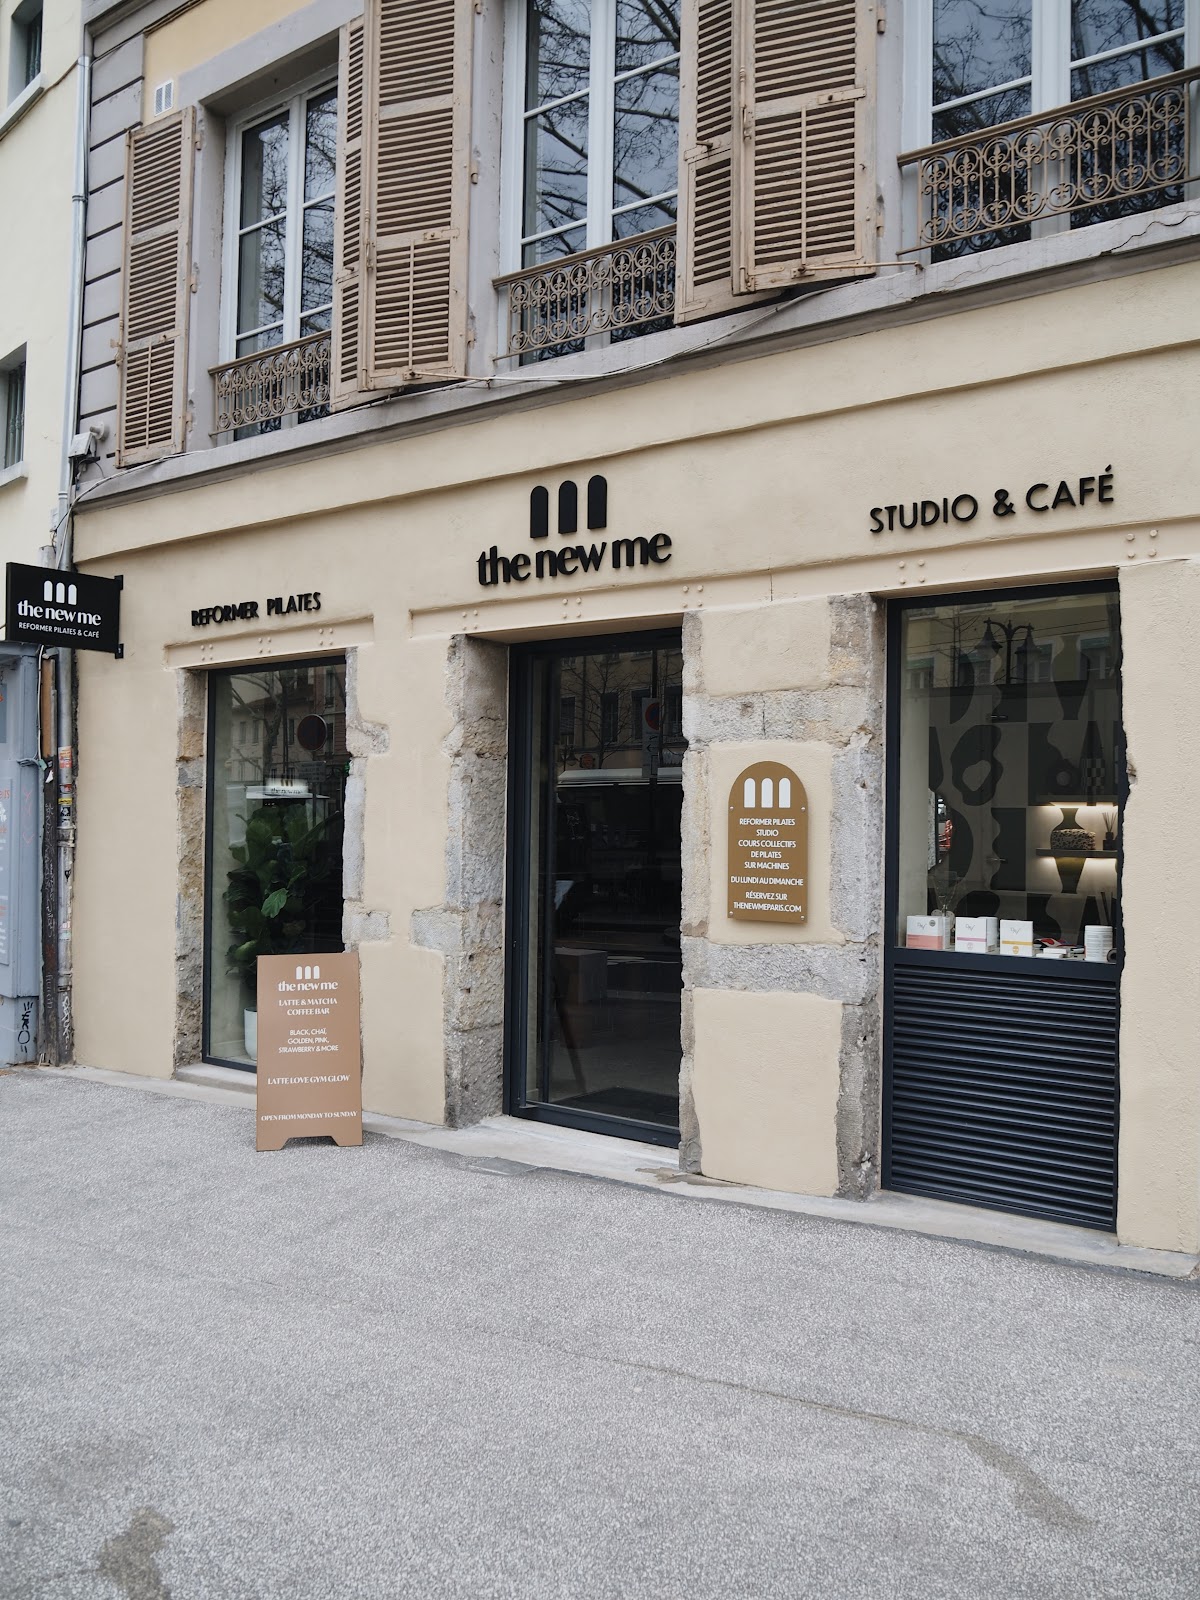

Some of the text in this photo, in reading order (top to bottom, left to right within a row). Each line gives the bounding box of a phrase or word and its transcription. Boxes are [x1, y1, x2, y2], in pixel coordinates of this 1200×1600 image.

[870, 464, 1114, 533] STUDIO & CAFÉ
[476, 533, 672, 586] the new me
[18, 600, 101, 626] the new me
[191, 592, 321, 626] REFORMER PILATES
[19, 622, 52, 632] REFORMER
[54, 627, 76, 636] PILATES
[83, 630, 99, 638] CAFÉ
[769, 878, 803, 886] DIMANCHE
[746, 891, 776, 900] RÉSERVEZ
[733, 902, 801, 912] THENEWMEPARIS.COM
[278, 981, 338, 991] the new me
